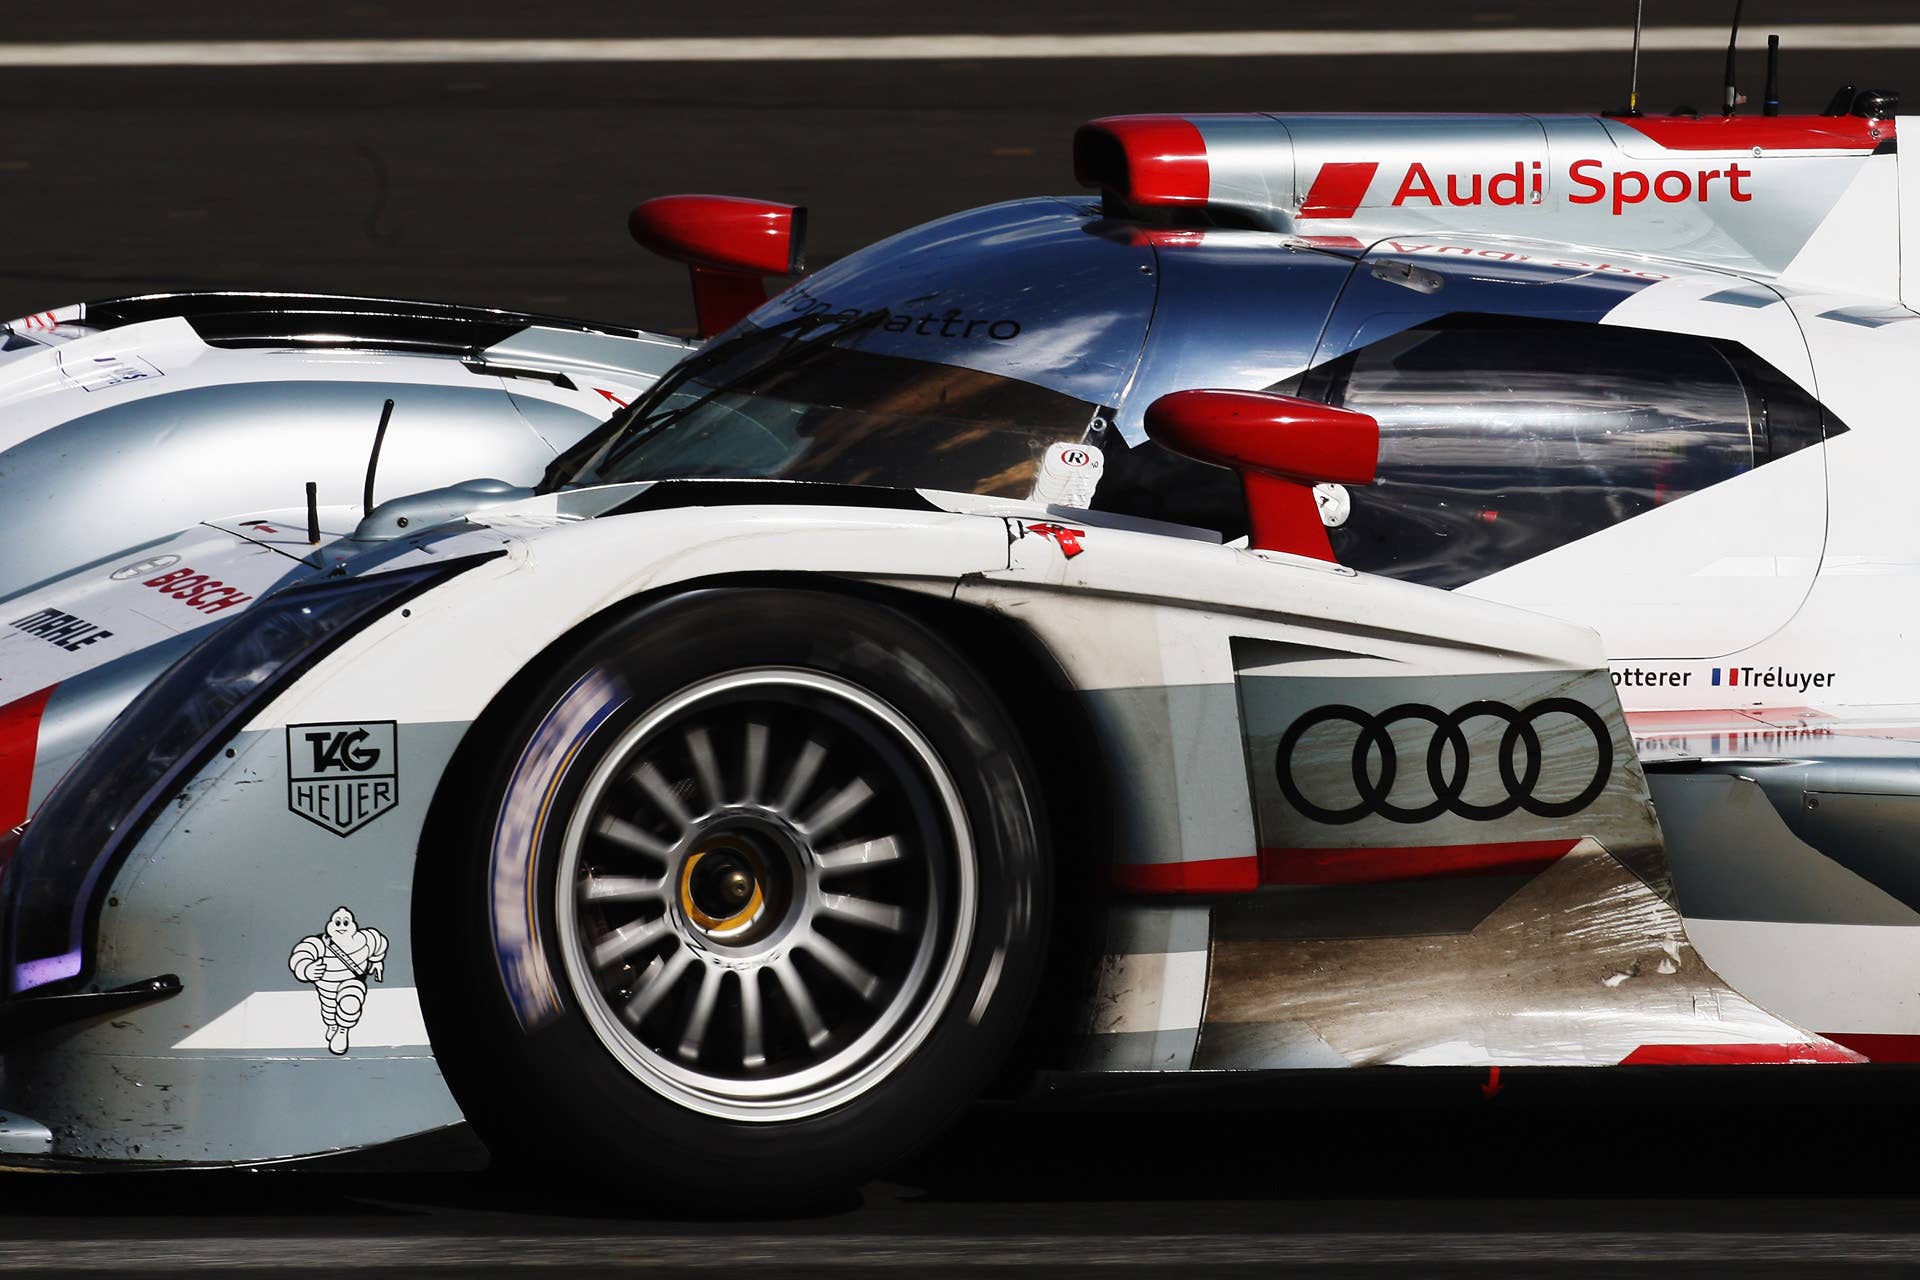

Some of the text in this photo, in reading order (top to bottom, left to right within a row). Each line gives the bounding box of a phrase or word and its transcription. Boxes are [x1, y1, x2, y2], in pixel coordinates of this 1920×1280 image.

[1391, 159, 1753, 216] Audi Sport
[142, 567, 253, 614] BOSCH
[8, 607, 114, 652] MAHLE
[1741, 666, 1836, 693] Tréluyer
[305, 727, 381, 773] TAG
[297, 782, 391, 828] HEUER
